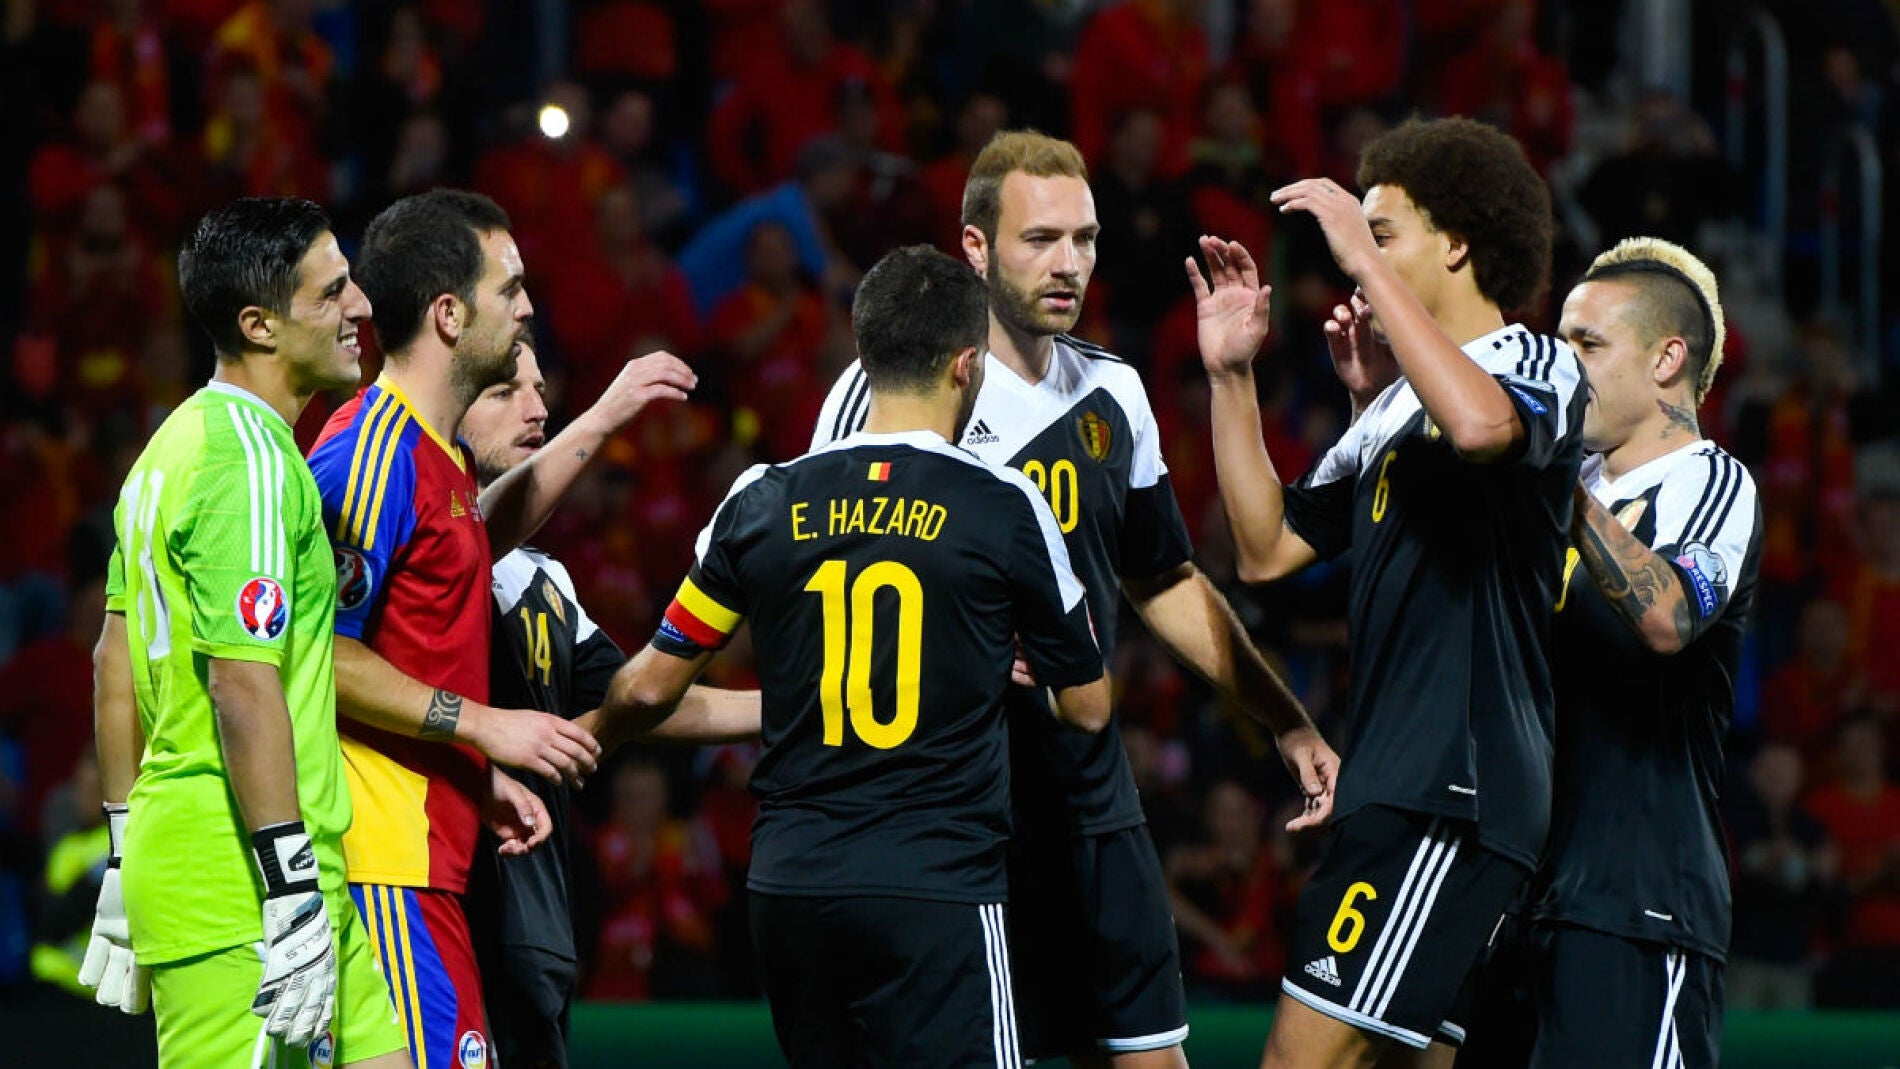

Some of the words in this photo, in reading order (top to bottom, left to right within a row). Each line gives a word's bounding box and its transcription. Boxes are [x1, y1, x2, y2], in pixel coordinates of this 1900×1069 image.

[967, 433, 1000, 445] adidas
[1372, 451, 1397, 523] 6
[791, 501, 818, 541] E.
[828, 496, 948, 541] HAZARD
[1691, 566, 1715, 613] RESPEC
[520, 606, 551, 686] 14
[803, 559, 924, 750] 10
[1326, 881, 1377, 953] 6
[1304, 963, 1342, 987] adidas
